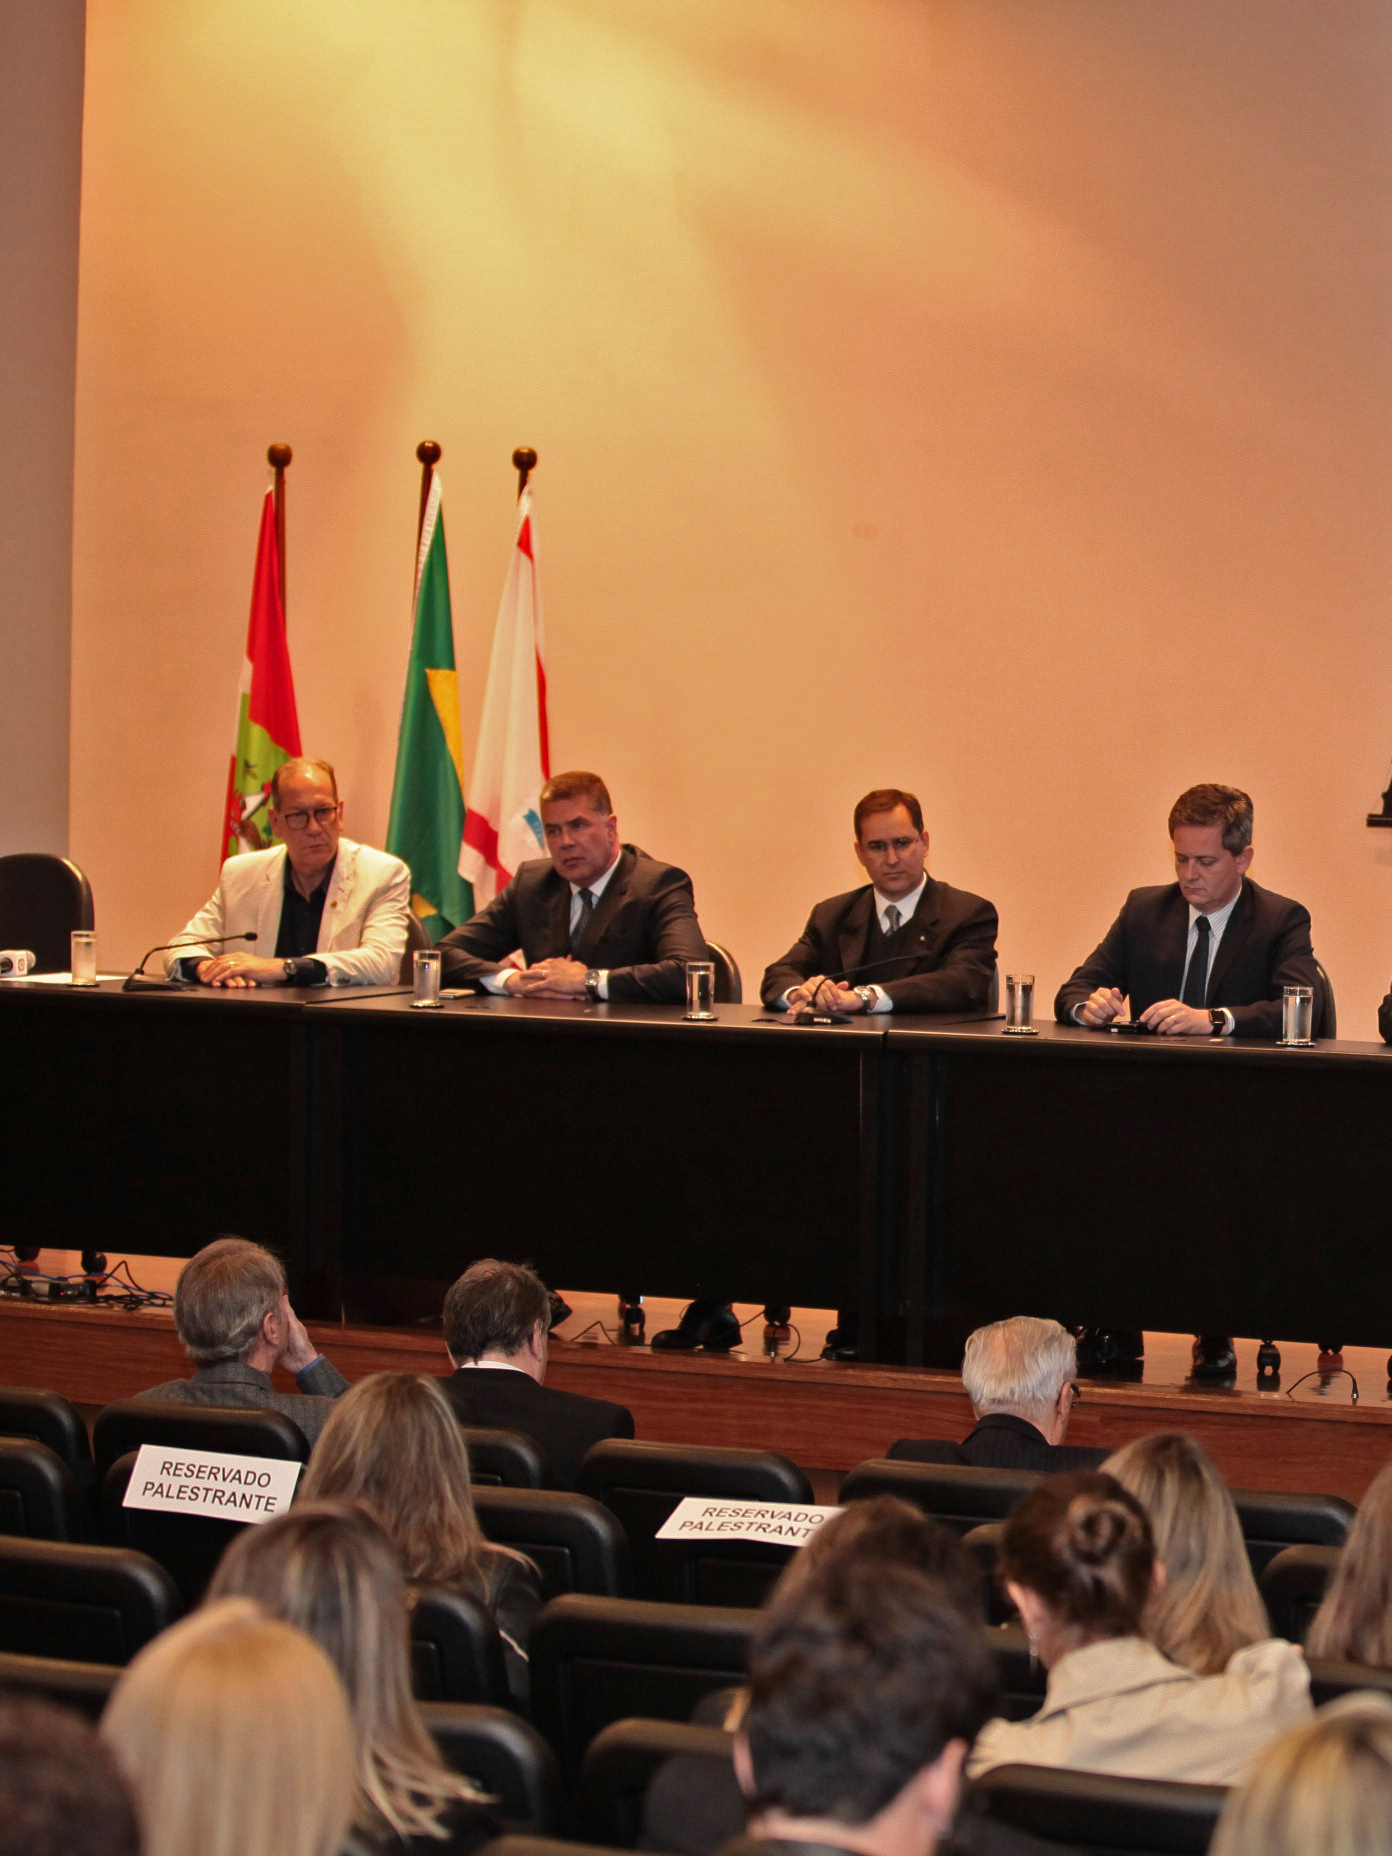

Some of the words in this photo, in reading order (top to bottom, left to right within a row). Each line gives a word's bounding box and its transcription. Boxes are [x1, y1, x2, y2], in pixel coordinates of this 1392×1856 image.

[159, 1460, 272, 1489] RESERVADO
[141, 1481, 278, 1513] PALESTRANTE
[701, 1506, 825, 1525] RESERVADO
[678, 1520, 818, 1539] PALESTRANT
